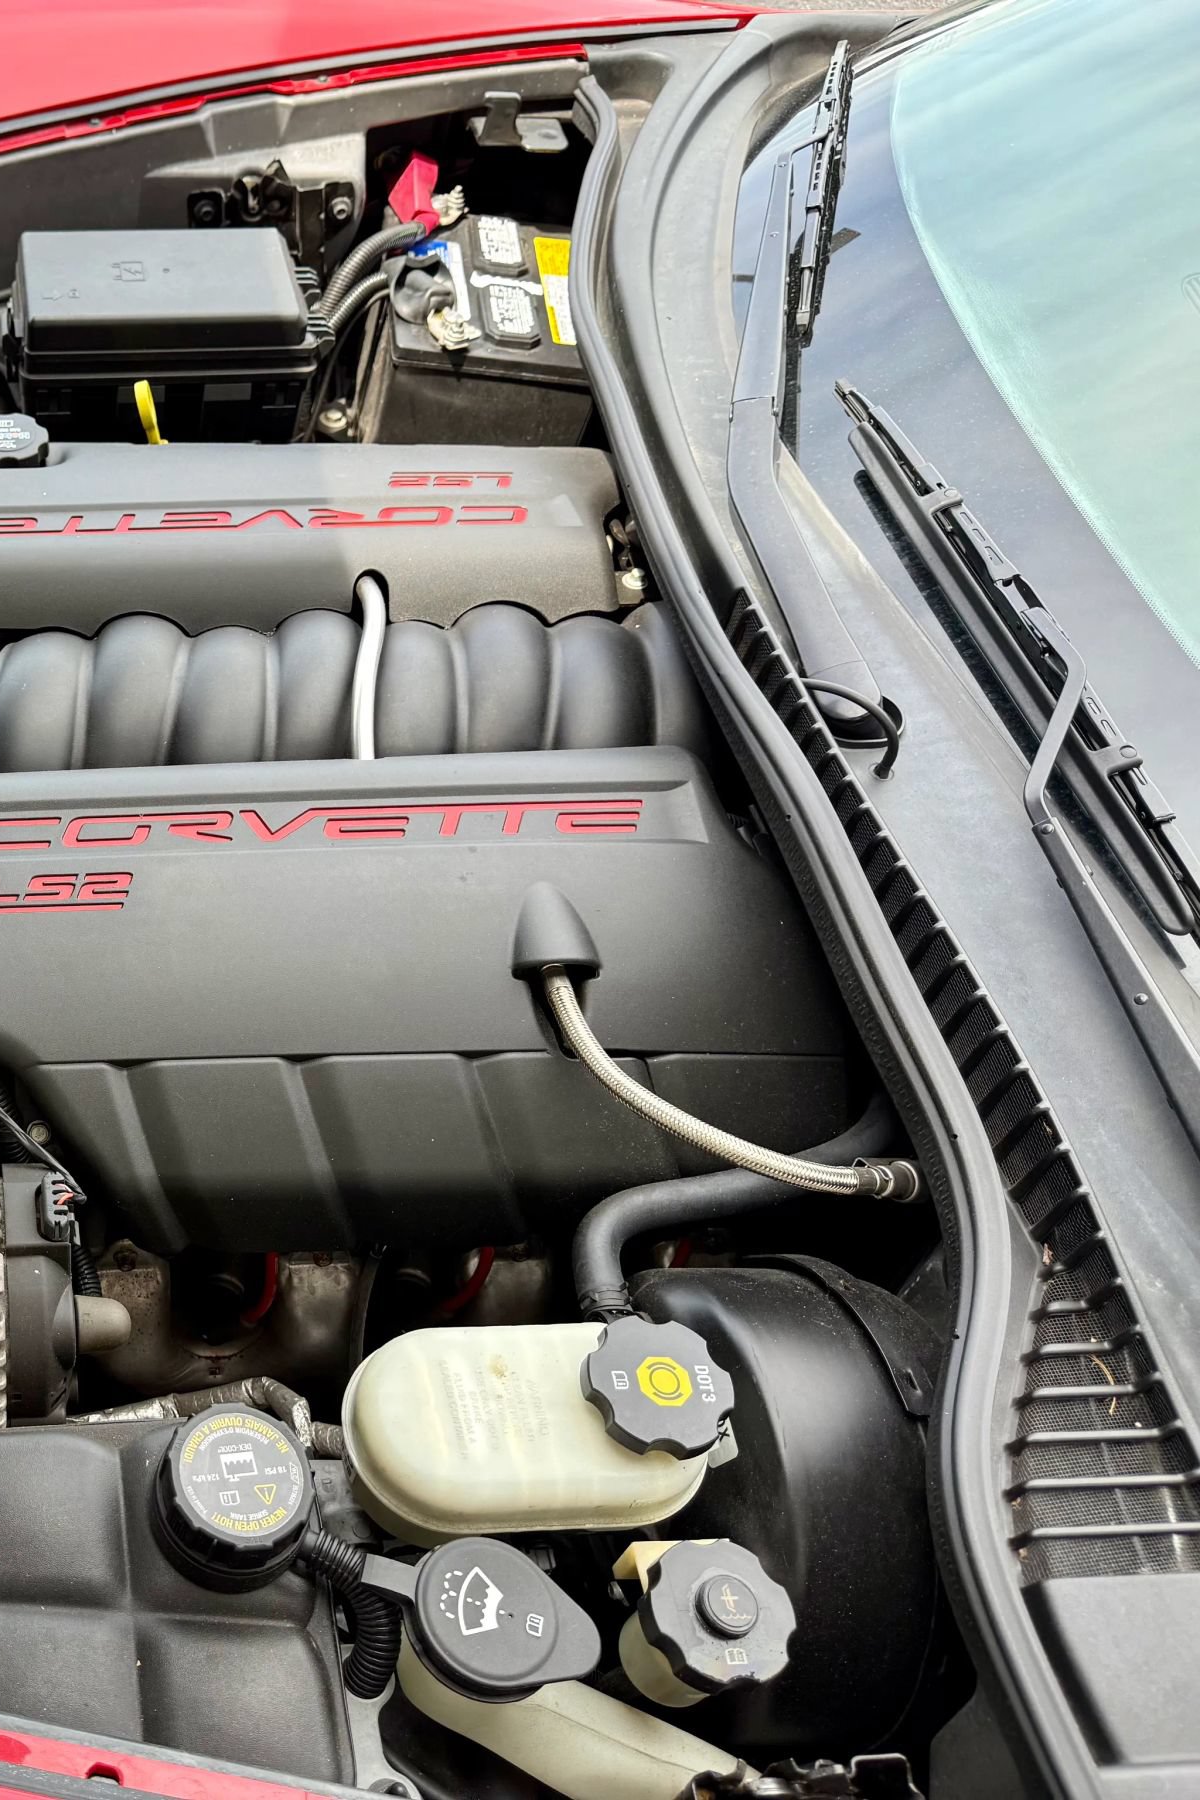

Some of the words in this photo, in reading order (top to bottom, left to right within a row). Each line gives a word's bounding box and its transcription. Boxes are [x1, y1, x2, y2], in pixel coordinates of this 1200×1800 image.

[388, 472, 513, 488] LS2
[694, 1365, 715, 1393] DOT
[701, 1392, 717, 1403] 3
[209, 1416, 243, 1430] OUVRIR
[244, 1419, 279, 1443] JAMAIS
[184, 1434, 205, 1464] CHAUD!
[275, 1440, 290, 1454] NE
[206, 1473, 220, 1481] 124
[264, 1466, 277, 1475] PSI
[210, 1512, 234, 1529] HOT!
[259, 1506, 288, 1528] NEVER
[234, 1520, 260, 1531] OPEN
